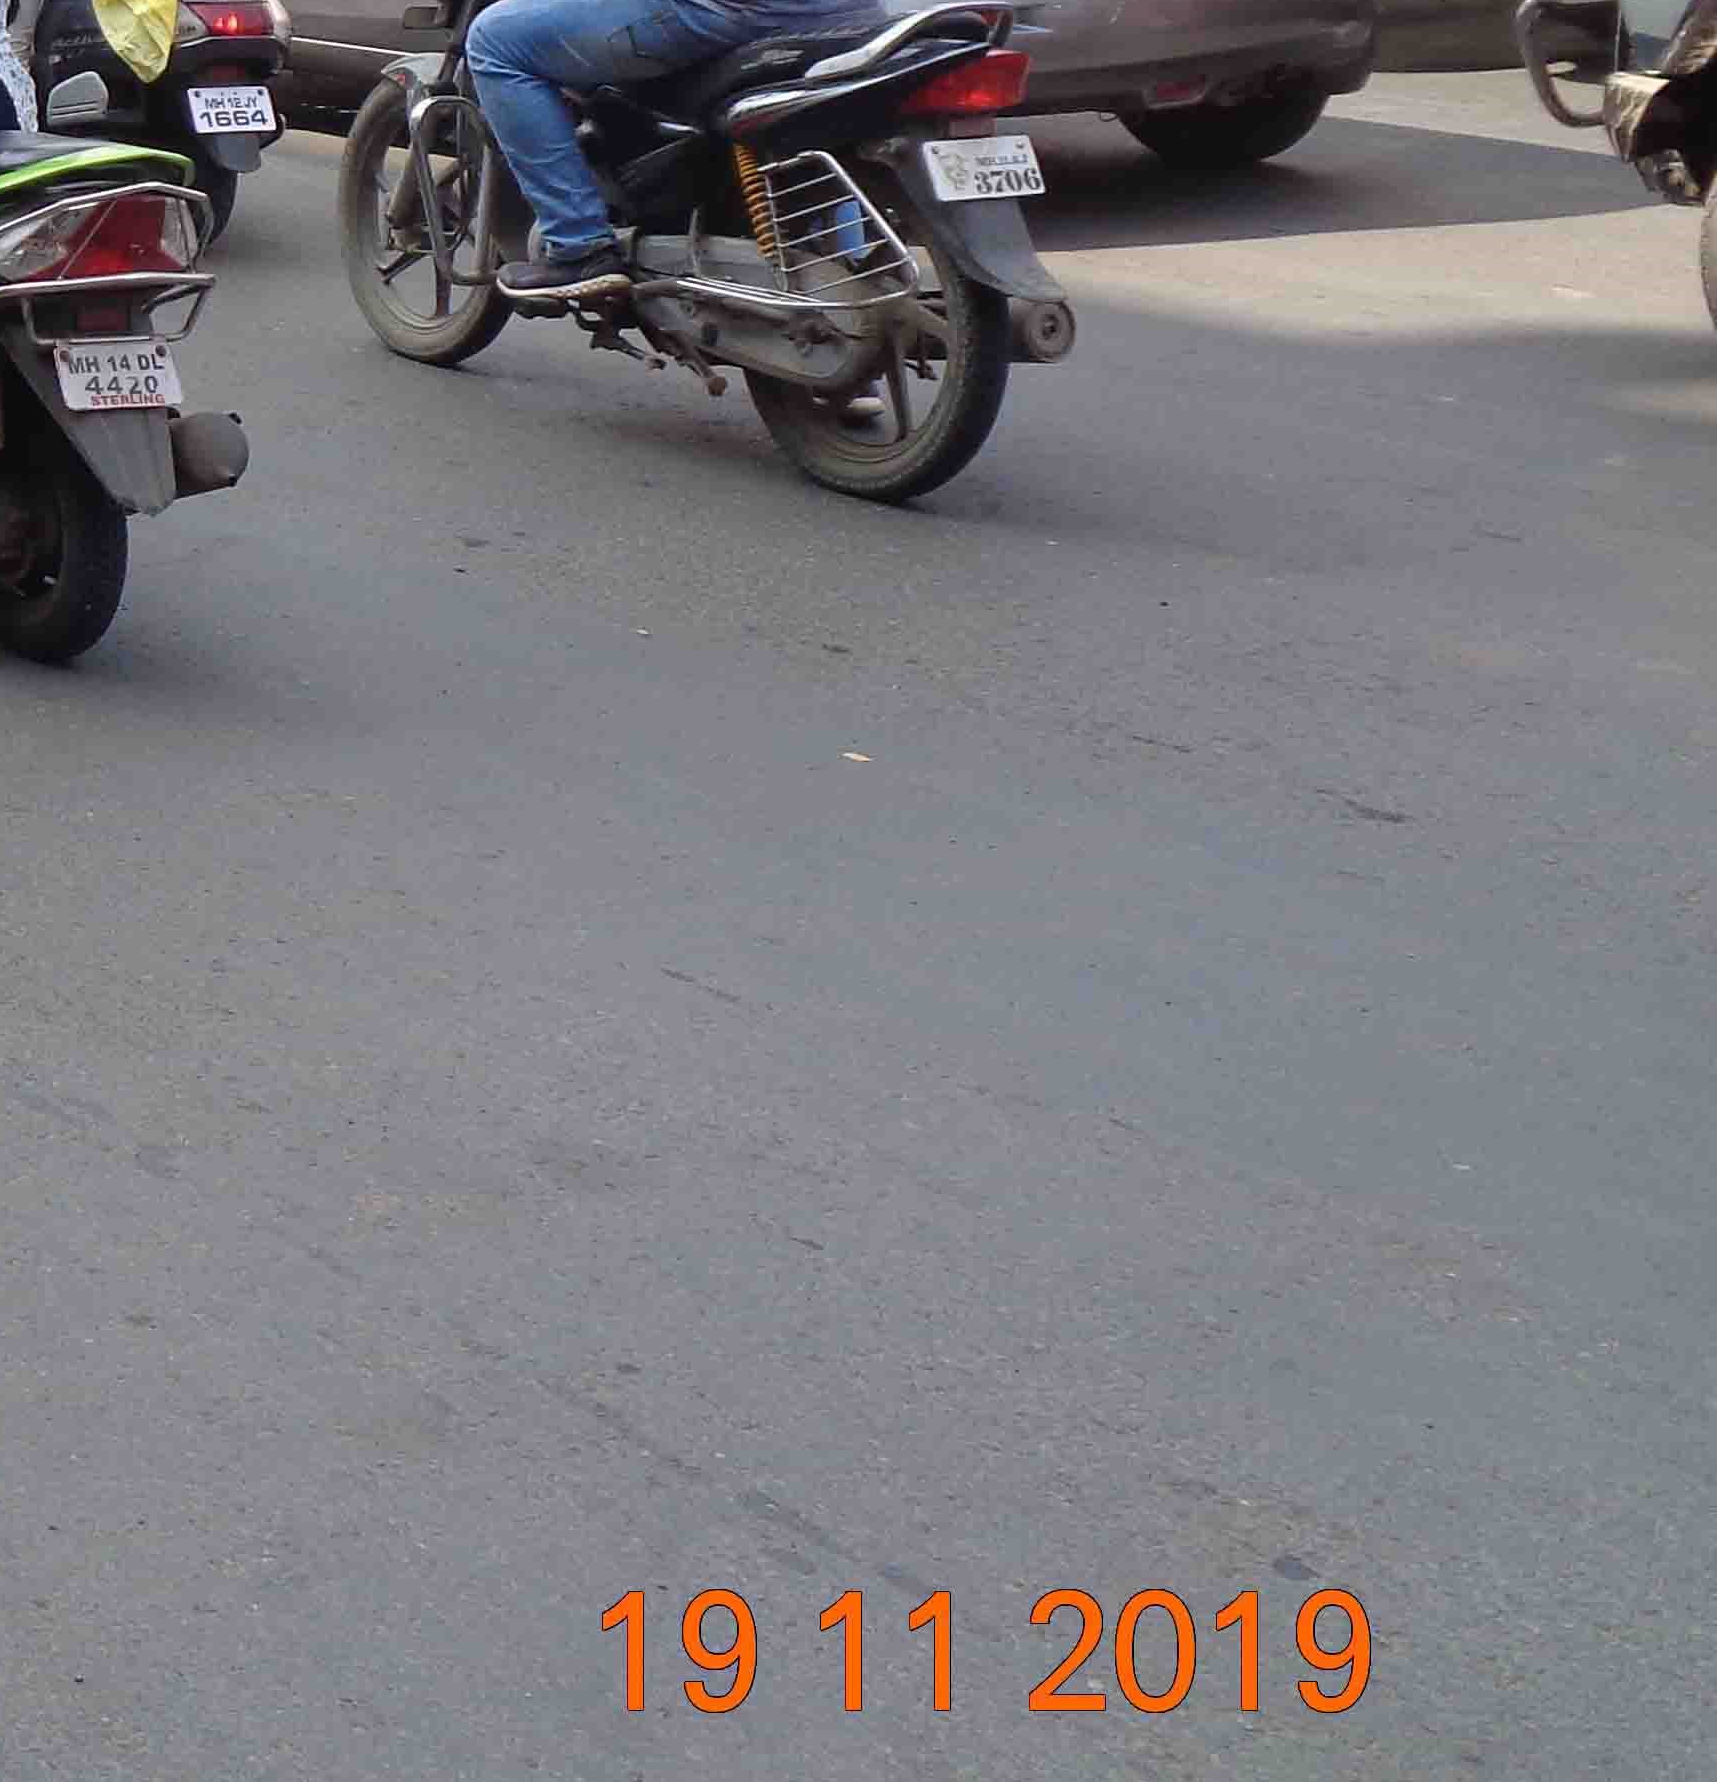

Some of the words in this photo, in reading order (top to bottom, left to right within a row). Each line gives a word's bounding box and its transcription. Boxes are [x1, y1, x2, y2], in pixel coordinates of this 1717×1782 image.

[205, 97, 226, 110] MH
[199, 109, 269, 129] 1664
[973, 167, 1042, 195] 3706
[69, 355, 101, 374] MH
[107, 354, 131, 372] 14
[137, 352, 165, 371] DL
[84, 374, 159, 396] 4420
[90, 393, 166, 407] STERLING
